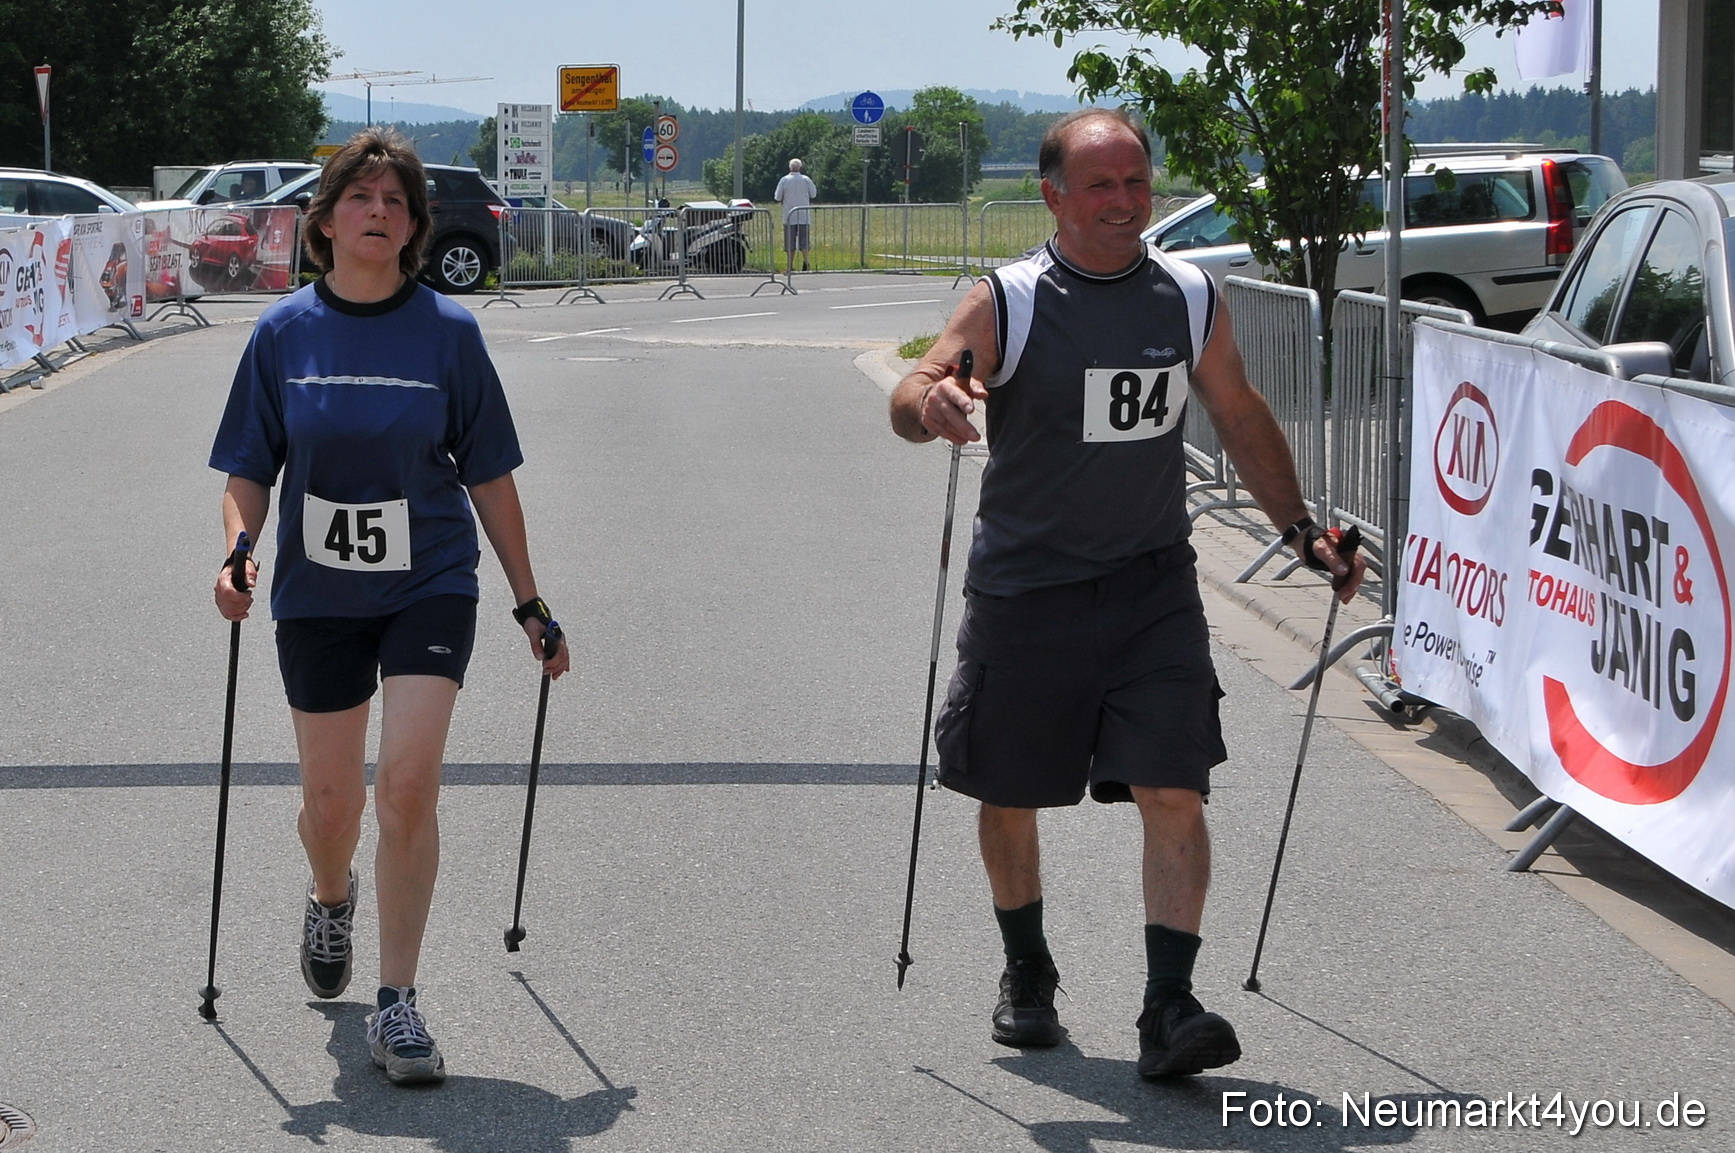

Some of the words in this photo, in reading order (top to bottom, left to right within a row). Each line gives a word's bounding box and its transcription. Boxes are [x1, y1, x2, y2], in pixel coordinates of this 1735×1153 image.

[565, 72, 613, 87] Sengenthal
[659, 123, 674, 137] 60
[1109, 371, 1170, 431] 84
[1446, 413, 1488, 489] KIA
[324, 508, 387, 564] 45
[1445, 550, 1508, 628] OTORS
[1527, 568, 1596, 627] TOHAUS
[1673, 545, 1694, 606] &
